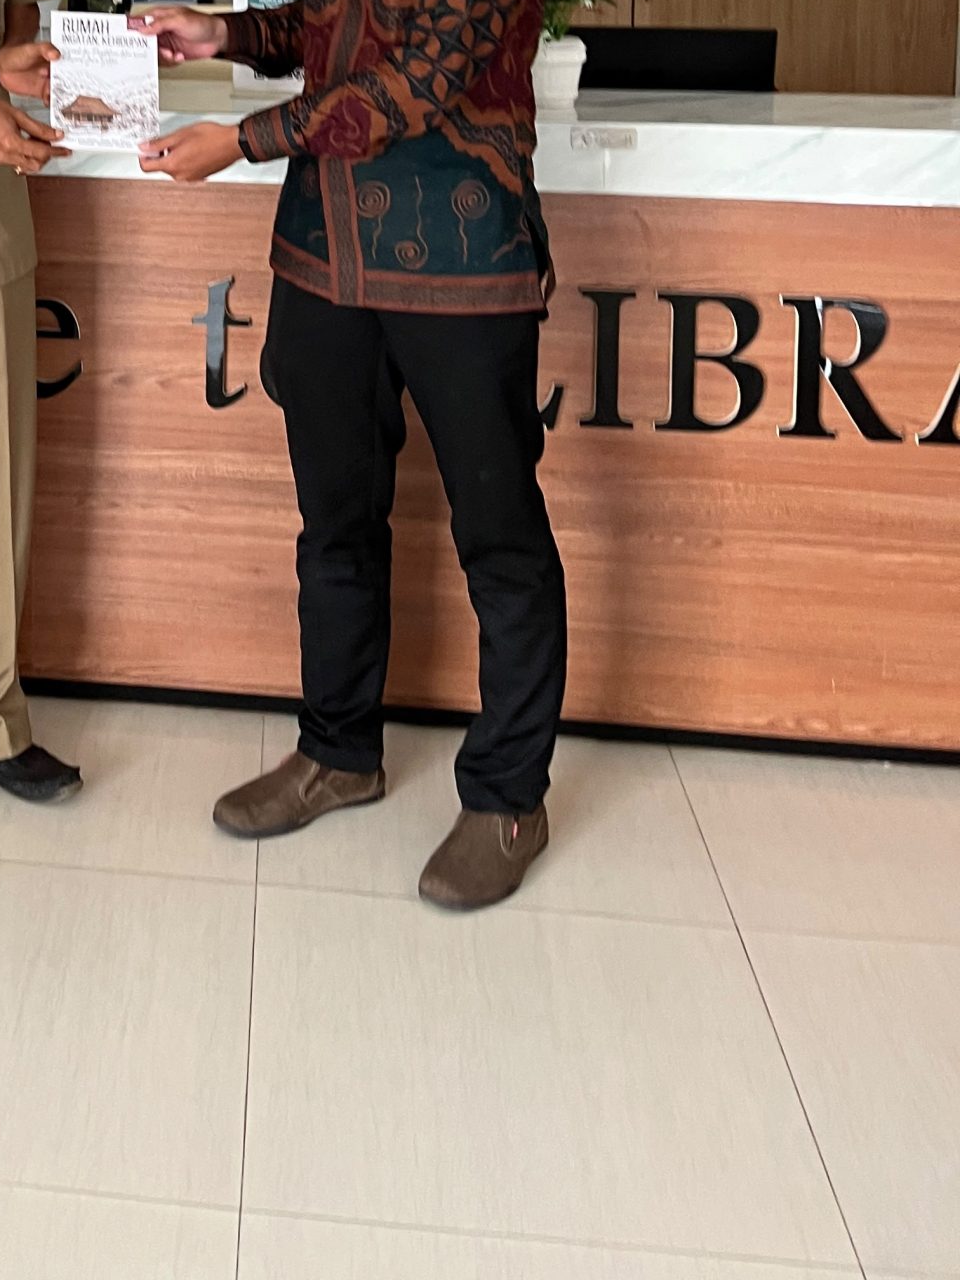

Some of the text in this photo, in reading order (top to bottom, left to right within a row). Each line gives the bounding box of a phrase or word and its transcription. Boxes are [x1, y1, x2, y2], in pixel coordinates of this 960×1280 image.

[62, 17, 110, 35] RUMAH
[192, 275, 280, 410] t
[540, 286, 960, 446] IBR
